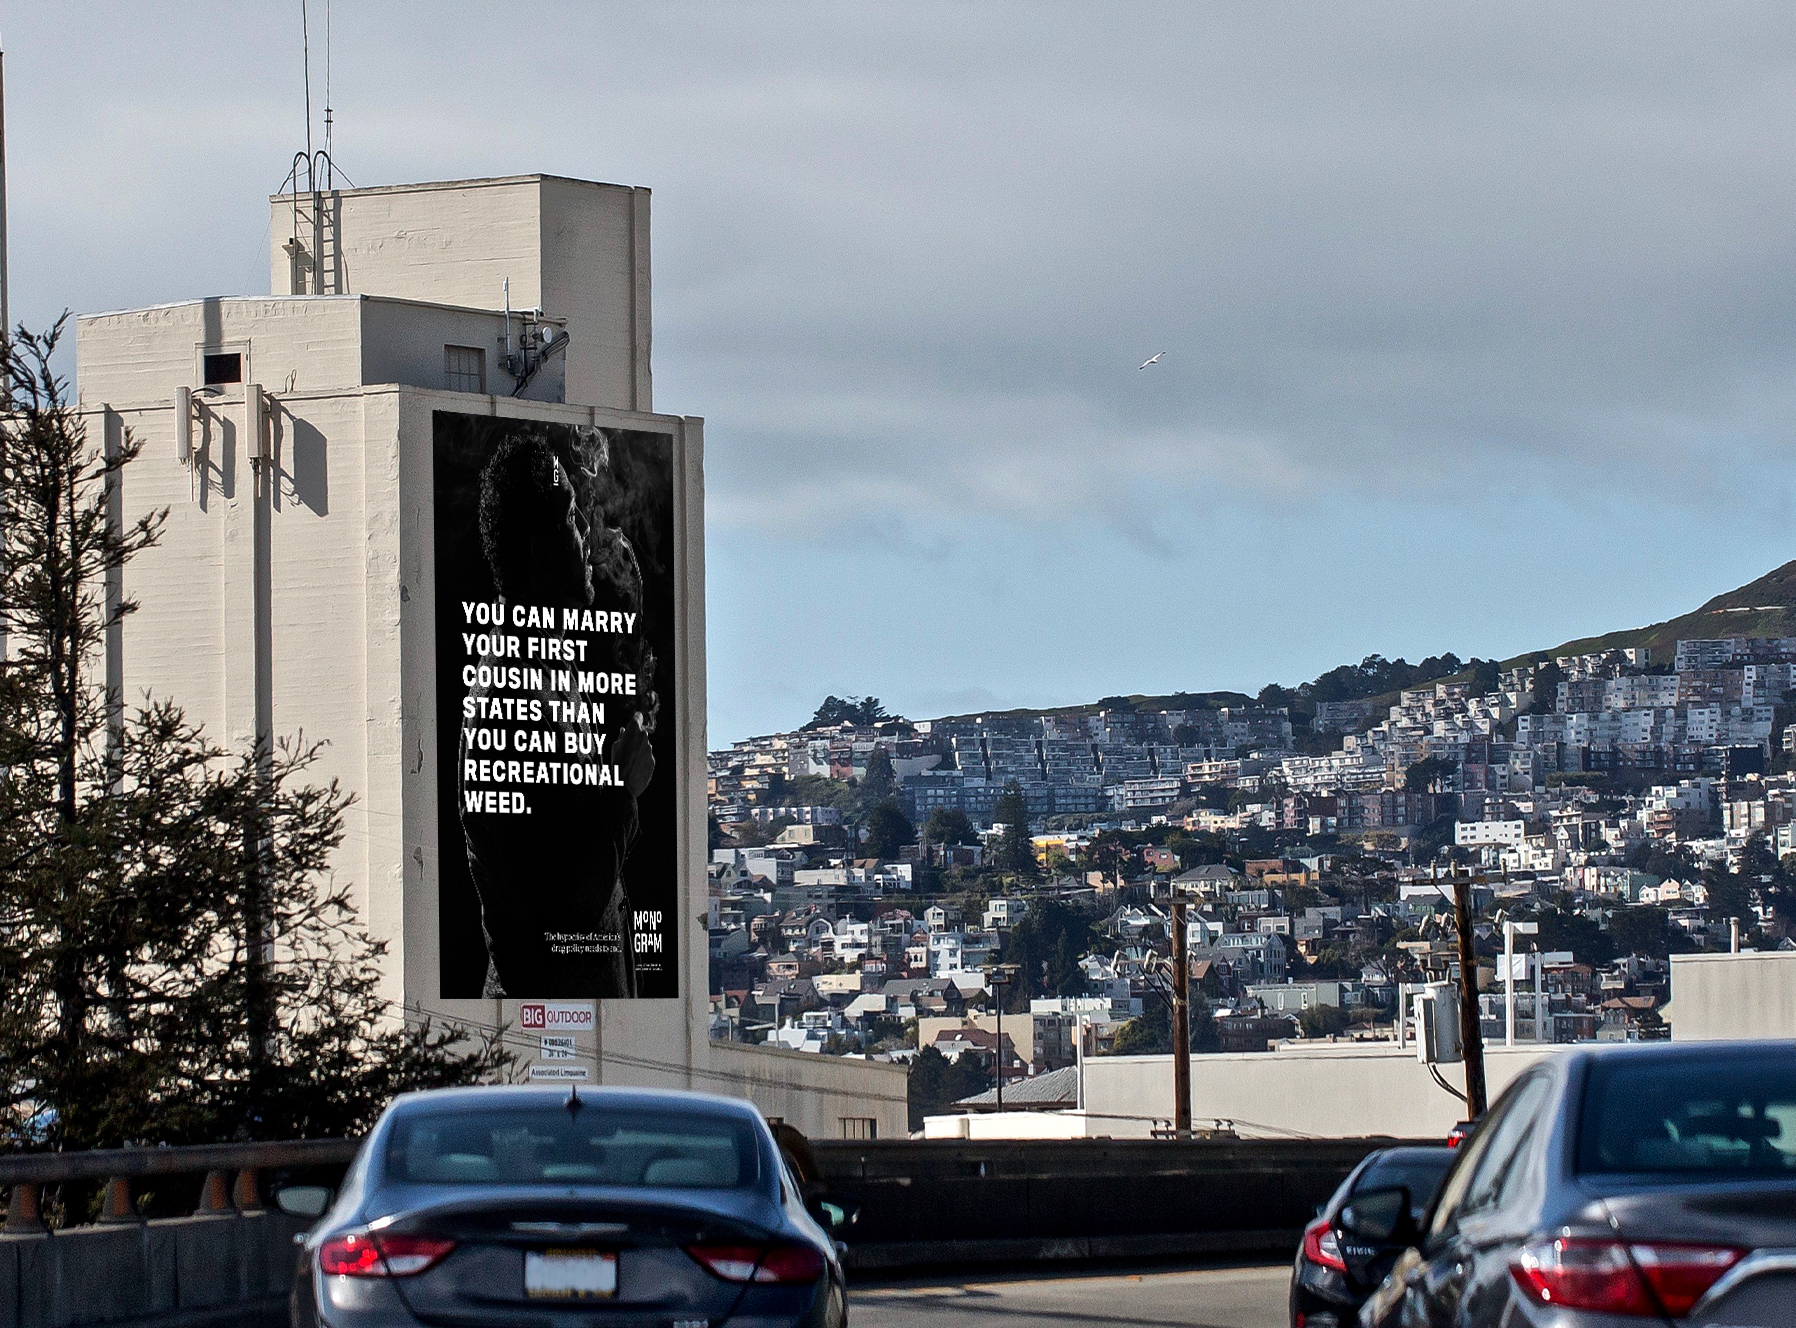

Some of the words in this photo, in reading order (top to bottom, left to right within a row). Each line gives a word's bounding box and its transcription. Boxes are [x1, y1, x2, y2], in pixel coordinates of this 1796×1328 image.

[462, 601, 505, 626] YOU
[512, 605, 555, 629] CAN
[563, 608, 637, 634] MARRY
[462, 632, 520, 658] YOUR
[527, 636, 588, 662] FIRST
[462, 664, 543, 690] COUSIN
[551, 669, 571, 692] IN
[578, 671, 637, 695] MORE
[462, 696, 542, 721] STATES
[549, 700, 605, 725] THAN
[464, 727, 506, 751] YOU
[514, 729, 556, 753] CAN
[564, 732, 606, 755] BUY
[464, 758, 624, 786] RECREATIONAL
[464, 790, 532, 814] WEED.
[633, 910, 662, 931] MONO
[634, 933, 662, 953] GRAM
[523, 1007, 543, 1026] BIG
[546, 1010, 592, 1024] OUTDOOR
